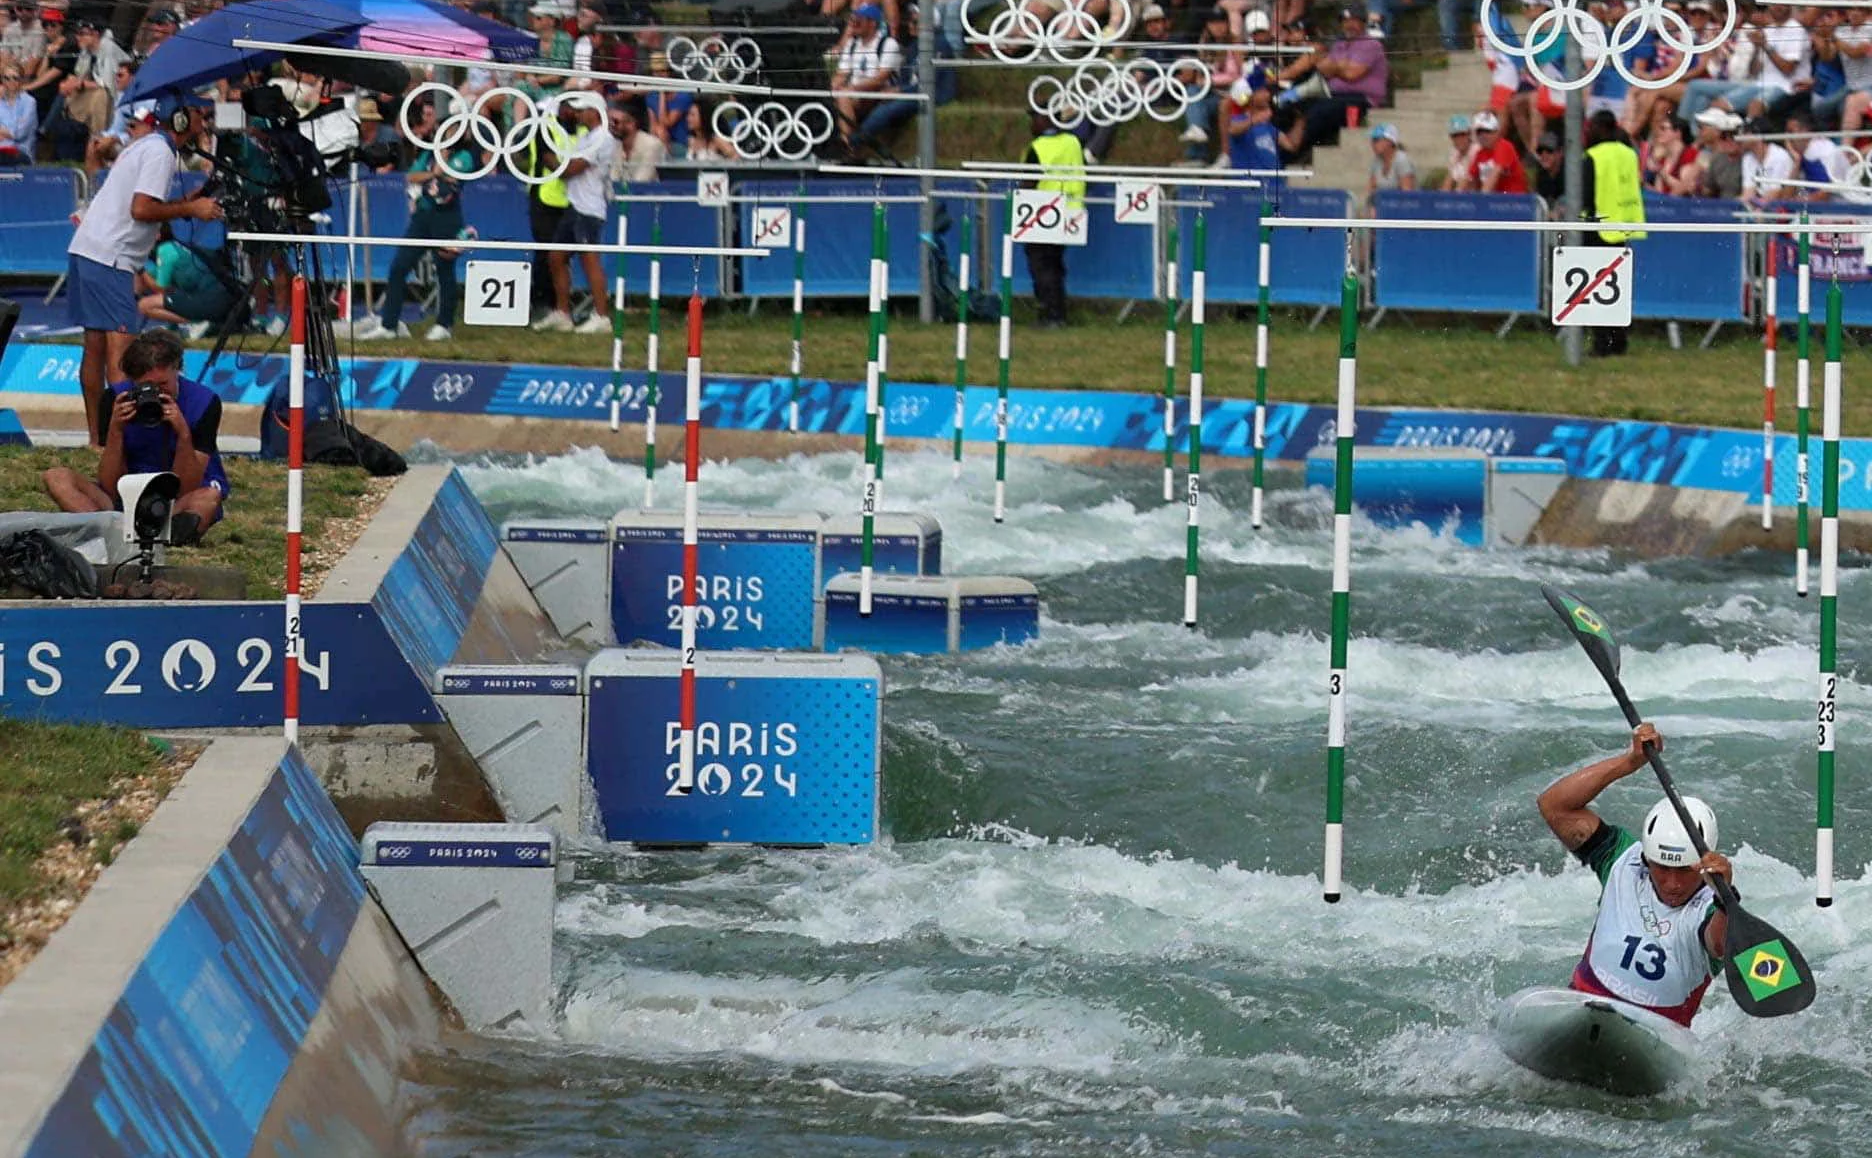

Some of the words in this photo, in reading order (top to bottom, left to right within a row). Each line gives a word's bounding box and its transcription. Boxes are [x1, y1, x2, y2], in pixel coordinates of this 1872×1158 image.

[1125, 193, 1149, 212] 18
[1017, 203, 1061, 229] 20
[481, 278, 515, 309] 21
[1565, 267, 1620, 305] 23
[867, 483, 874, 497] 2
[1191, 478, 1198, 491] 2
[290, 617, 299, 634] 2
[667, 605, 763, 631] 2024
[686, 647, 695, 664] 2
[104, 638, 330, 695] 2024
[1331, 674, 1340, 695] 3
[1827, 678, 1836, 698] 2
[1818, 701, 1834, 721] 23
[1817, 723, 1826, 745] 3
[665, 763, 797, 797] 2024
[1660, 852, 1682, 862] BRA
[1620, 935, 1667, 981] 13
